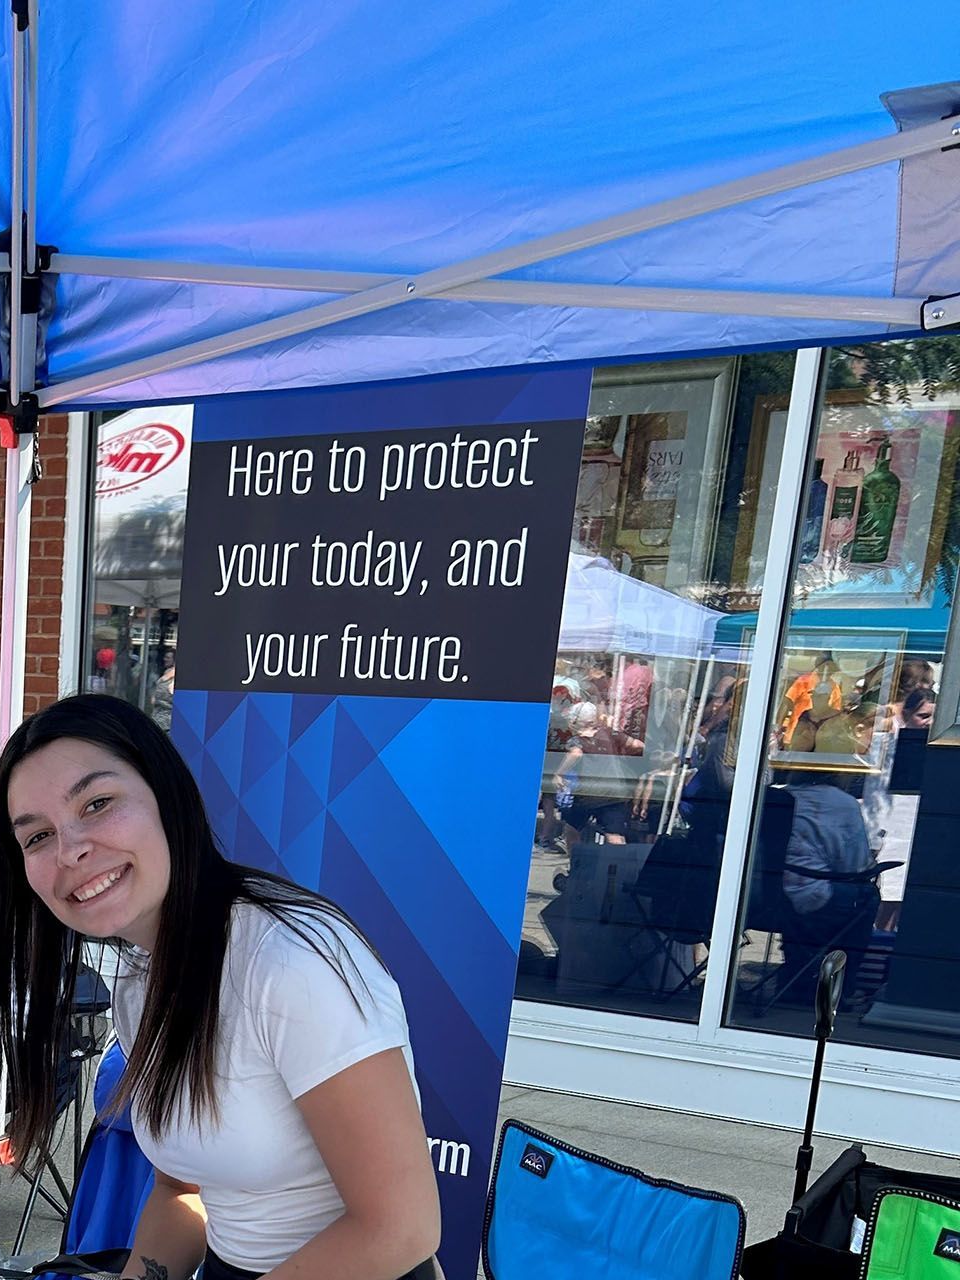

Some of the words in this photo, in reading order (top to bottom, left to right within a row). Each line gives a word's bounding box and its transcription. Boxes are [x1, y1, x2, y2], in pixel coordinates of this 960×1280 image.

[227, 445, 314, 497] Here
[329, 440, 366, 493] to
[379, 429, 539, 500] protect
[214, 541, 299, 596] your
[312, 529, 430, 596] today,
[447, 527, 529, 587] and
[242, 631, 329, 685] your
[339, 623, 470, 683] future.
[524, 1158, 543, 1171] MAC
